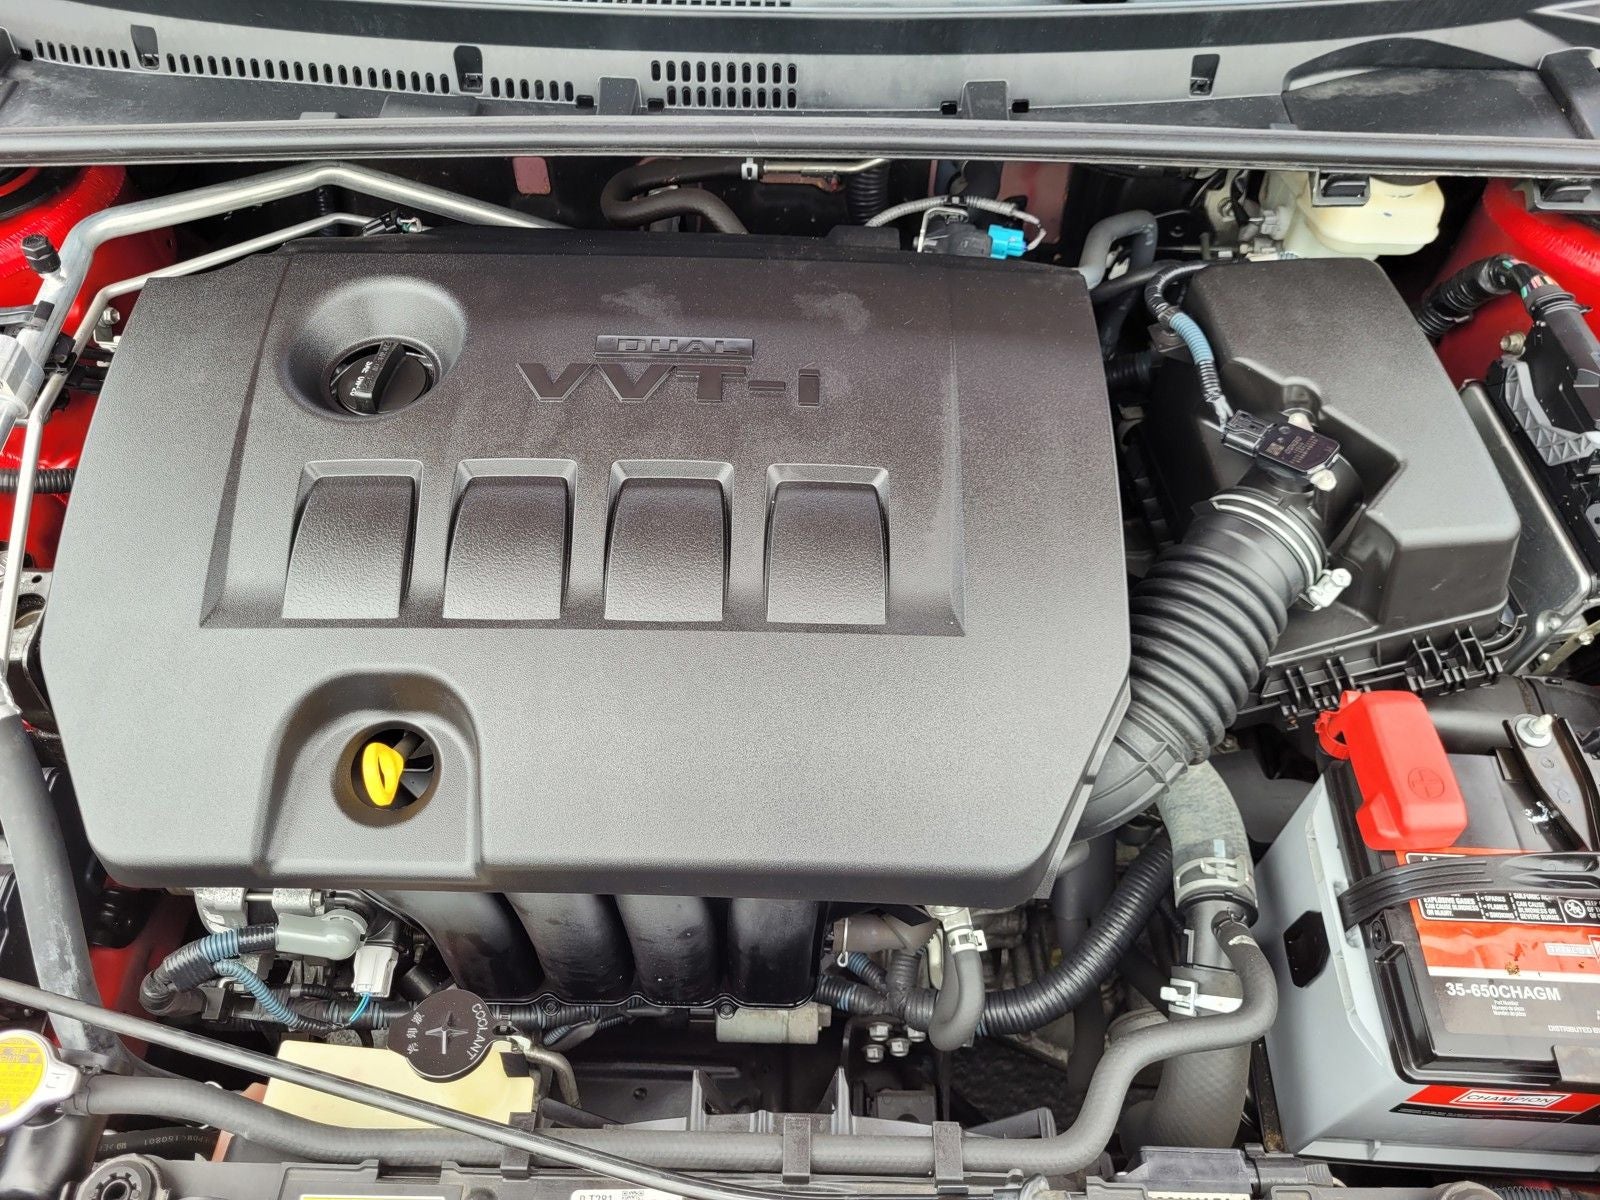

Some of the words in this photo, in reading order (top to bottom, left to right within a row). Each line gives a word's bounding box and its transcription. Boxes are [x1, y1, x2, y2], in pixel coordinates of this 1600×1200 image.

[617, 338, 739, 352] DUAL
[1452, 904, 1480, 912] BLINDNESS
[1488, 903, 1510, 911] FLAMES
[1445, 982, 1561, 1001] 35-650CHAGM
[466, 1003, 489, 1061] COOLANT
[1466, 1094, 1553, 1104] CHAMPION
